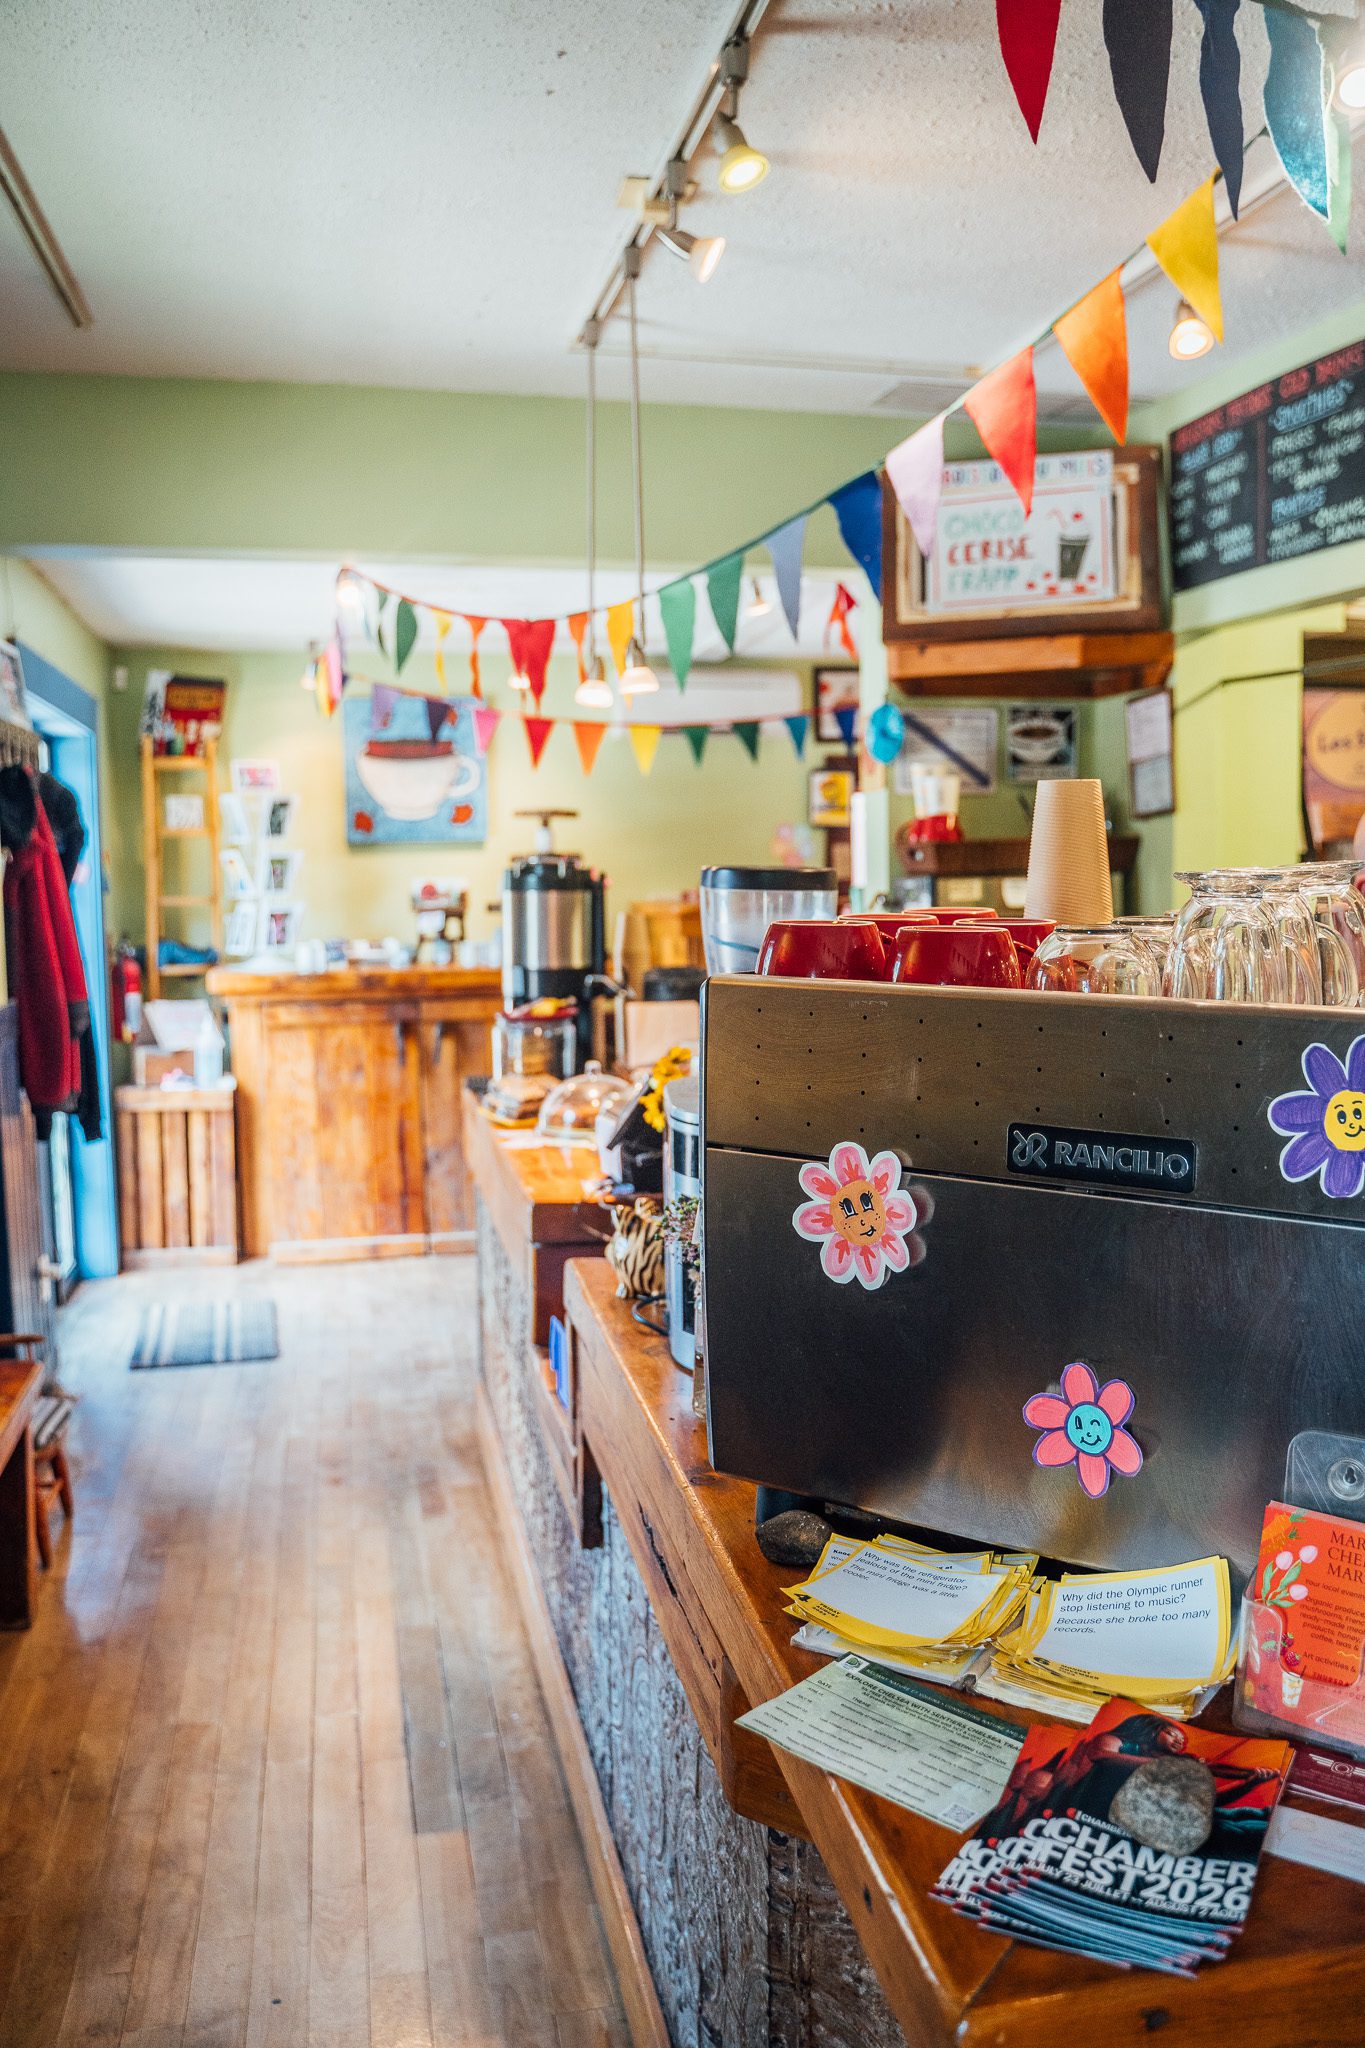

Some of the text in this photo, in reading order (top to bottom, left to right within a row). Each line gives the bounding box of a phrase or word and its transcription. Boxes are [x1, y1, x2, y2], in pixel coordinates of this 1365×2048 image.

[1054, 1141, 1189, 1179] RANCILIO
[864, 1551, 966, 1584] Why was the refrigerator
[1328, 1547, 1365, 1567] CHE
[842, 1568, 869, 1581] cooler.
[850, 1564, 866, 1573] The
[866, 1570, 886, 1579] mini
[886, 1576, 911, 1588] fridge
[912, 1583, 930, 1592] was
[938, 1589, 959, 1600] little
[855, 1557, 887, 1571] jealous
[889, 1568, 900, 1576] of
[900, 1571, 915, 1580] the
[917, 1576, 936, 1587] mini
[937, 1578, 968, 1592] fridge?
[1327, 1563, 1365, 1583] MAR
[794, 1593, 812, 1603] 4
[1062, 1577, 1204, 1603] Why did the Olympic runner
[1321, 1582, 1340, 1593] local
[820, 1603, 840, 1615] FRIDAY
[1060, 1593, 1186, 1614] stop listening to music?
[1056, 1608, 1211, 1625] Because she broke too many
[1053, 1625, 1097, 1634] records.
[845, 1672, 878, 1690] EXPLORE
[877, 1687, 909, 1705] CHELSEA
[910, 1701, 929, 1713] WITH
[929, 1708, 966, 1730] SENTIERS
[967, 1724, 1001, 1744] CHELSEA
[1003, 1740, 1020, 1752] TRA
[1045, 1817, 1258, 1888] CHAMBER
[1062, 1872, 1080, 1887] 23
[1081, 1878, 1131, 1901] JUILLET
[1144, 1896, 1197, 1914] AUGUST
